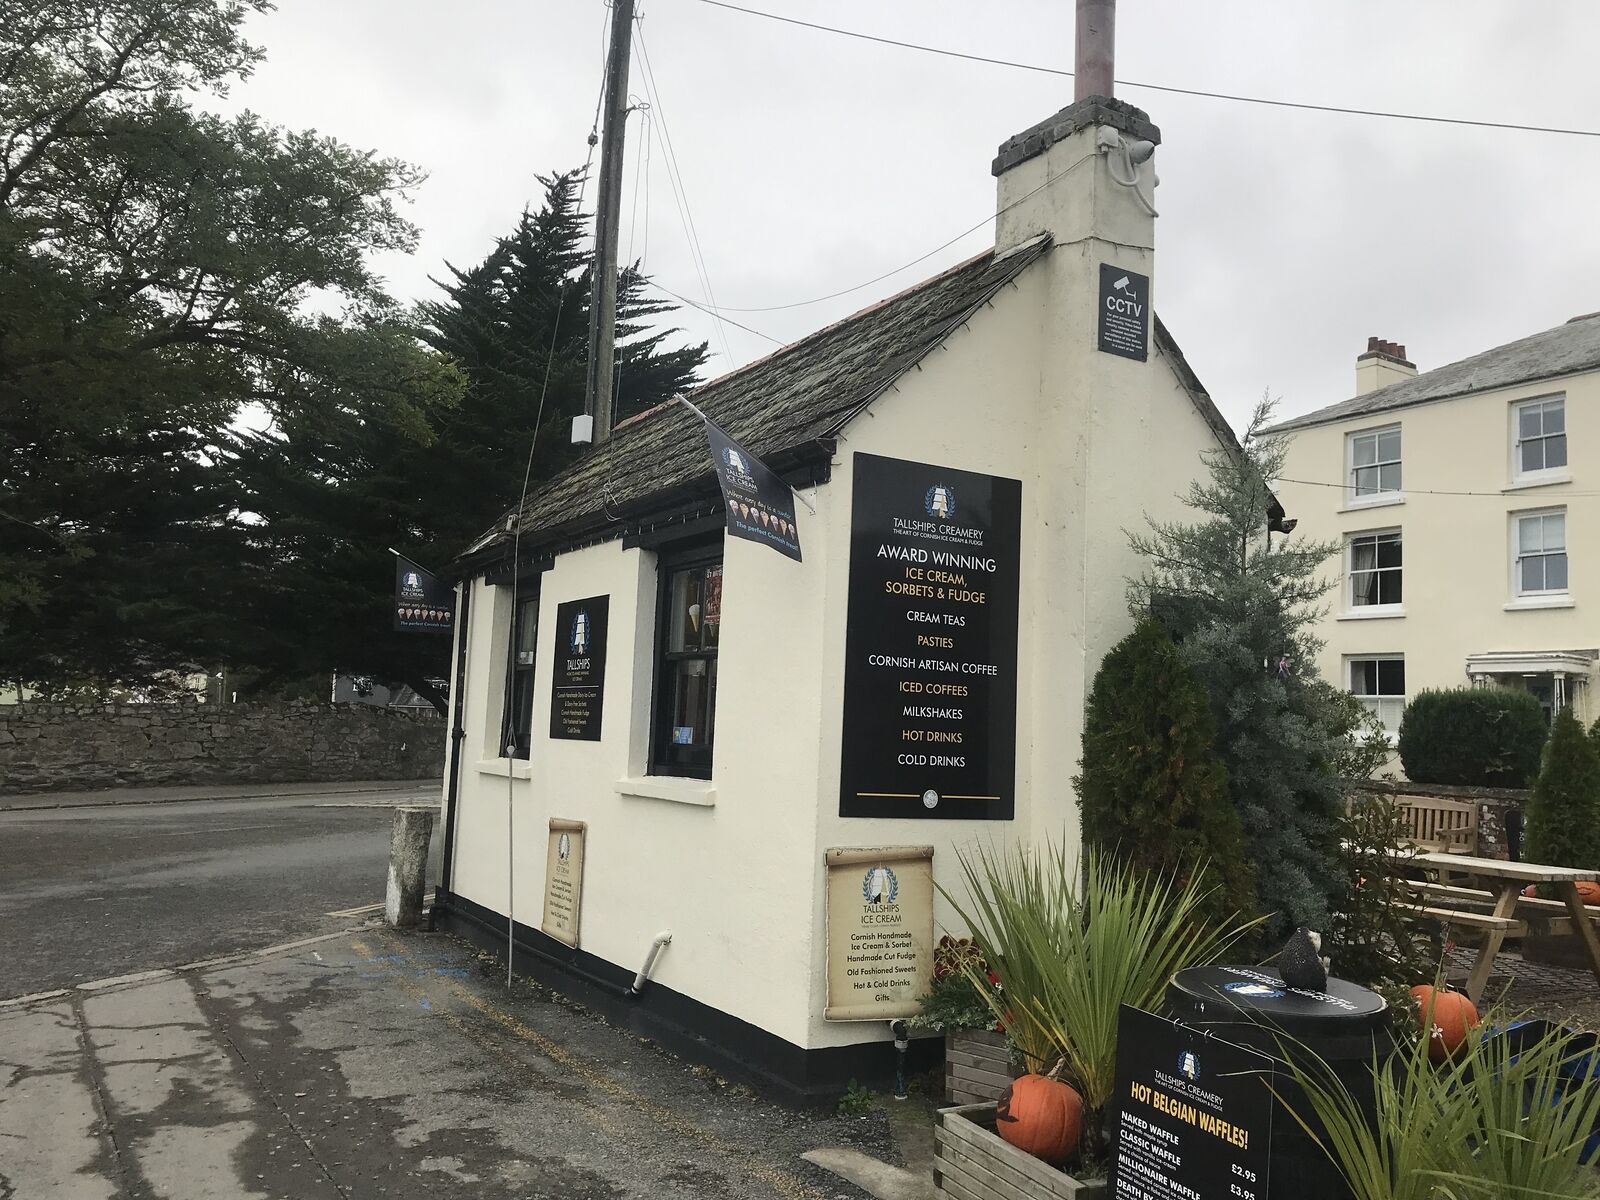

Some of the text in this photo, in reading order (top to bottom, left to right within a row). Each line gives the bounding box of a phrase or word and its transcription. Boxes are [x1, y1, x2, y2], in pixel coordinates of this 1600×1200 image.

[1106, 296, 1142, 317] CCTV
[893, 517, 984, 540] TALLSHIPS CREAMERY
[920, 532, 940, 540] CORNISH
[876, 544, 997, 573] AWARD WINNING
[905, 567, 968, 587] ICE CREAM,
[885, 581, 986, 604] SORBETS & FUDGE
[906, 610, 966, 627] CREAM TEAS
[917, 635, 954, 649] PASTIES
[567, 658, 590, 671] TALLSHIPS
[868, 654, 998, 676] CORNISH ARTISAN COFFEE
[899, 681, 968, 697] ICED COFFEES
[902, 706, 963, 720] MILKSHAKES
[902, 730, 963, 744] HOT DRINKS
[897, 754, 966, 768] COLD DRINKS
[863, 904, 900, 913] TALLSHIPS
[861, 914, 902, 924] ICE CREAM
[851, 931, 912, 941] Cornish Handmade
[862, 942, 884, 950] Cream
[885, 941, 890, 949] &
[891, 941, 912, 949] Sorbet
[847, 954, 882, 962] Handmade
[896, 951, 916, 961] Fudge
[846, 965, 917, 976] Old Fashioned Sweets
[866, 981, 872, 989] &
[873, 980, 889, 988] Cold
[890, 979, 911, 987] Drinks
[874, 993, 890, 1002] Gifts
[1154, 1069, 1224, 1105] TALLSHIPS CREAMERY
[1131, 1081, 1249, 1150] HOT BELGIAN WAFFLES!
[1121, 1110, 1179, 1146] NAKED WAFFLE
[1120, 1129, 1181, 1166] CLASSIC WAFFLE
[1120, 1138, 1177, 1171] Served with vanilla ice-cream
[1118, 1153, 1201, 1200] MILLIONAIRE WAFFLE
[1231, 1163, 1257, 1183] £2.95
[1117, 1178, 1154, 1200] DEATH BY
[1230, 1183, 1256, 1200] £3.95
